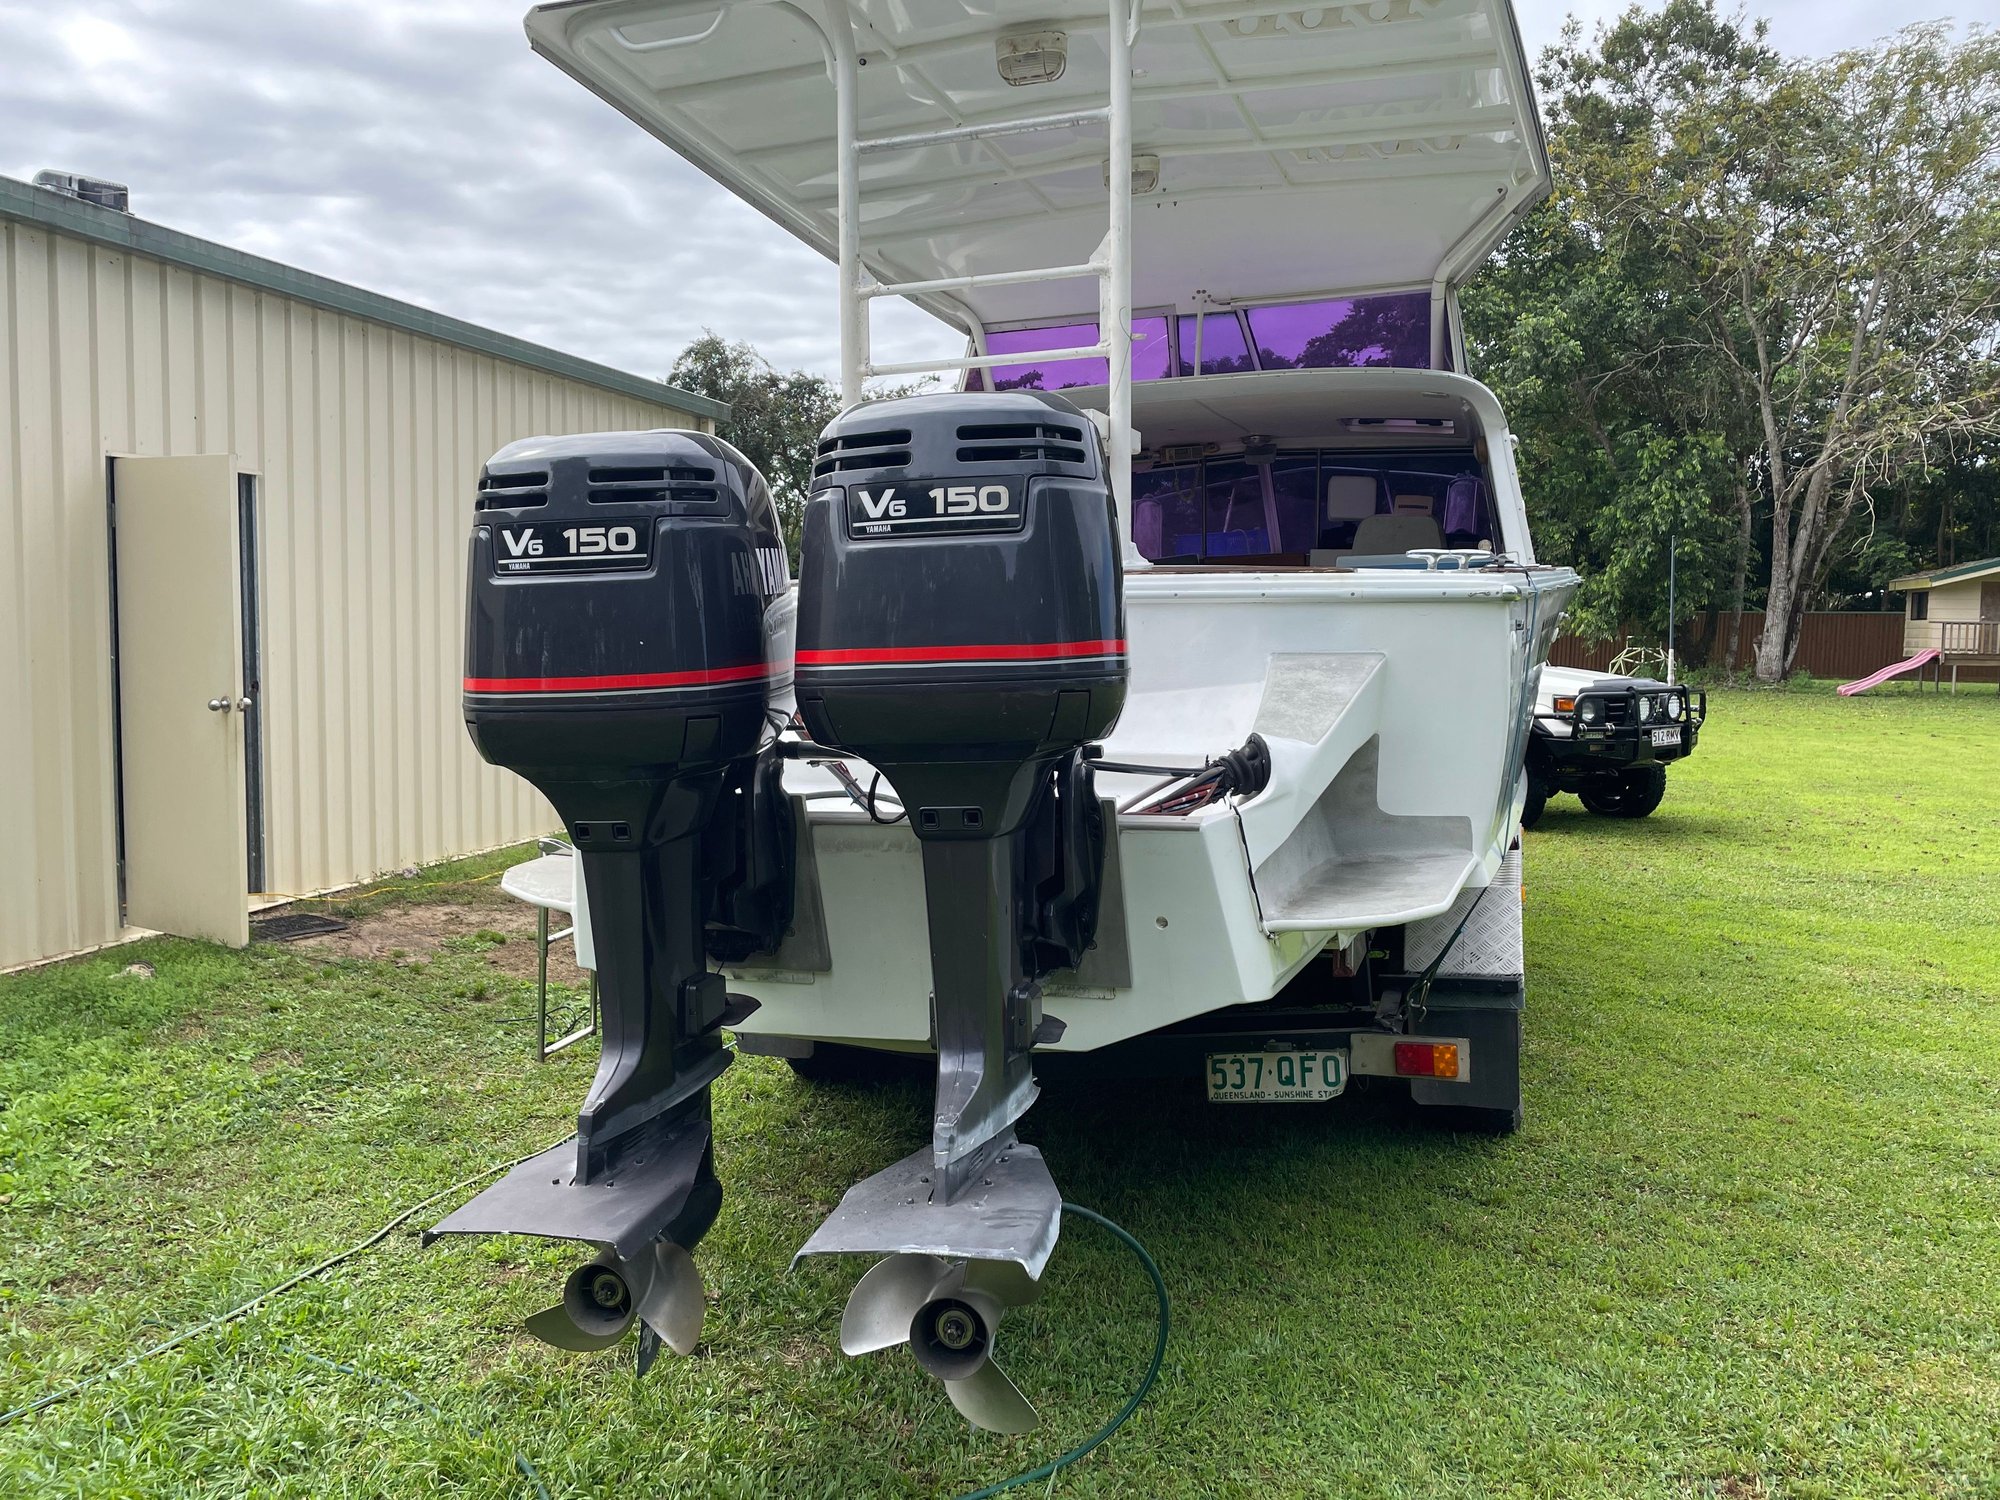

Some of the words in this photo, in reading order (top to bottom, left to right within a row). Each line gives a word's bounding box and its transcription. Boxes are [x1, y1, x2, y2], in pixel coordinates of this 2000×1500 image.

[858, 488, 907, 519] V6
[928, 485, 1010, 514] 150
[865, 524, 892, 534] YAMAHA
[501, 528, 544, 557] V6
[562, 526, 637, 554] 150
[508, 562, 531, 571] YAMAHA
[1213, 1092, 1266, 1100] QUEENSLAND
[1274, 1090, 1314, 1099] SUNSHINE
[1317, 1089, 1340, 1099] STATE
